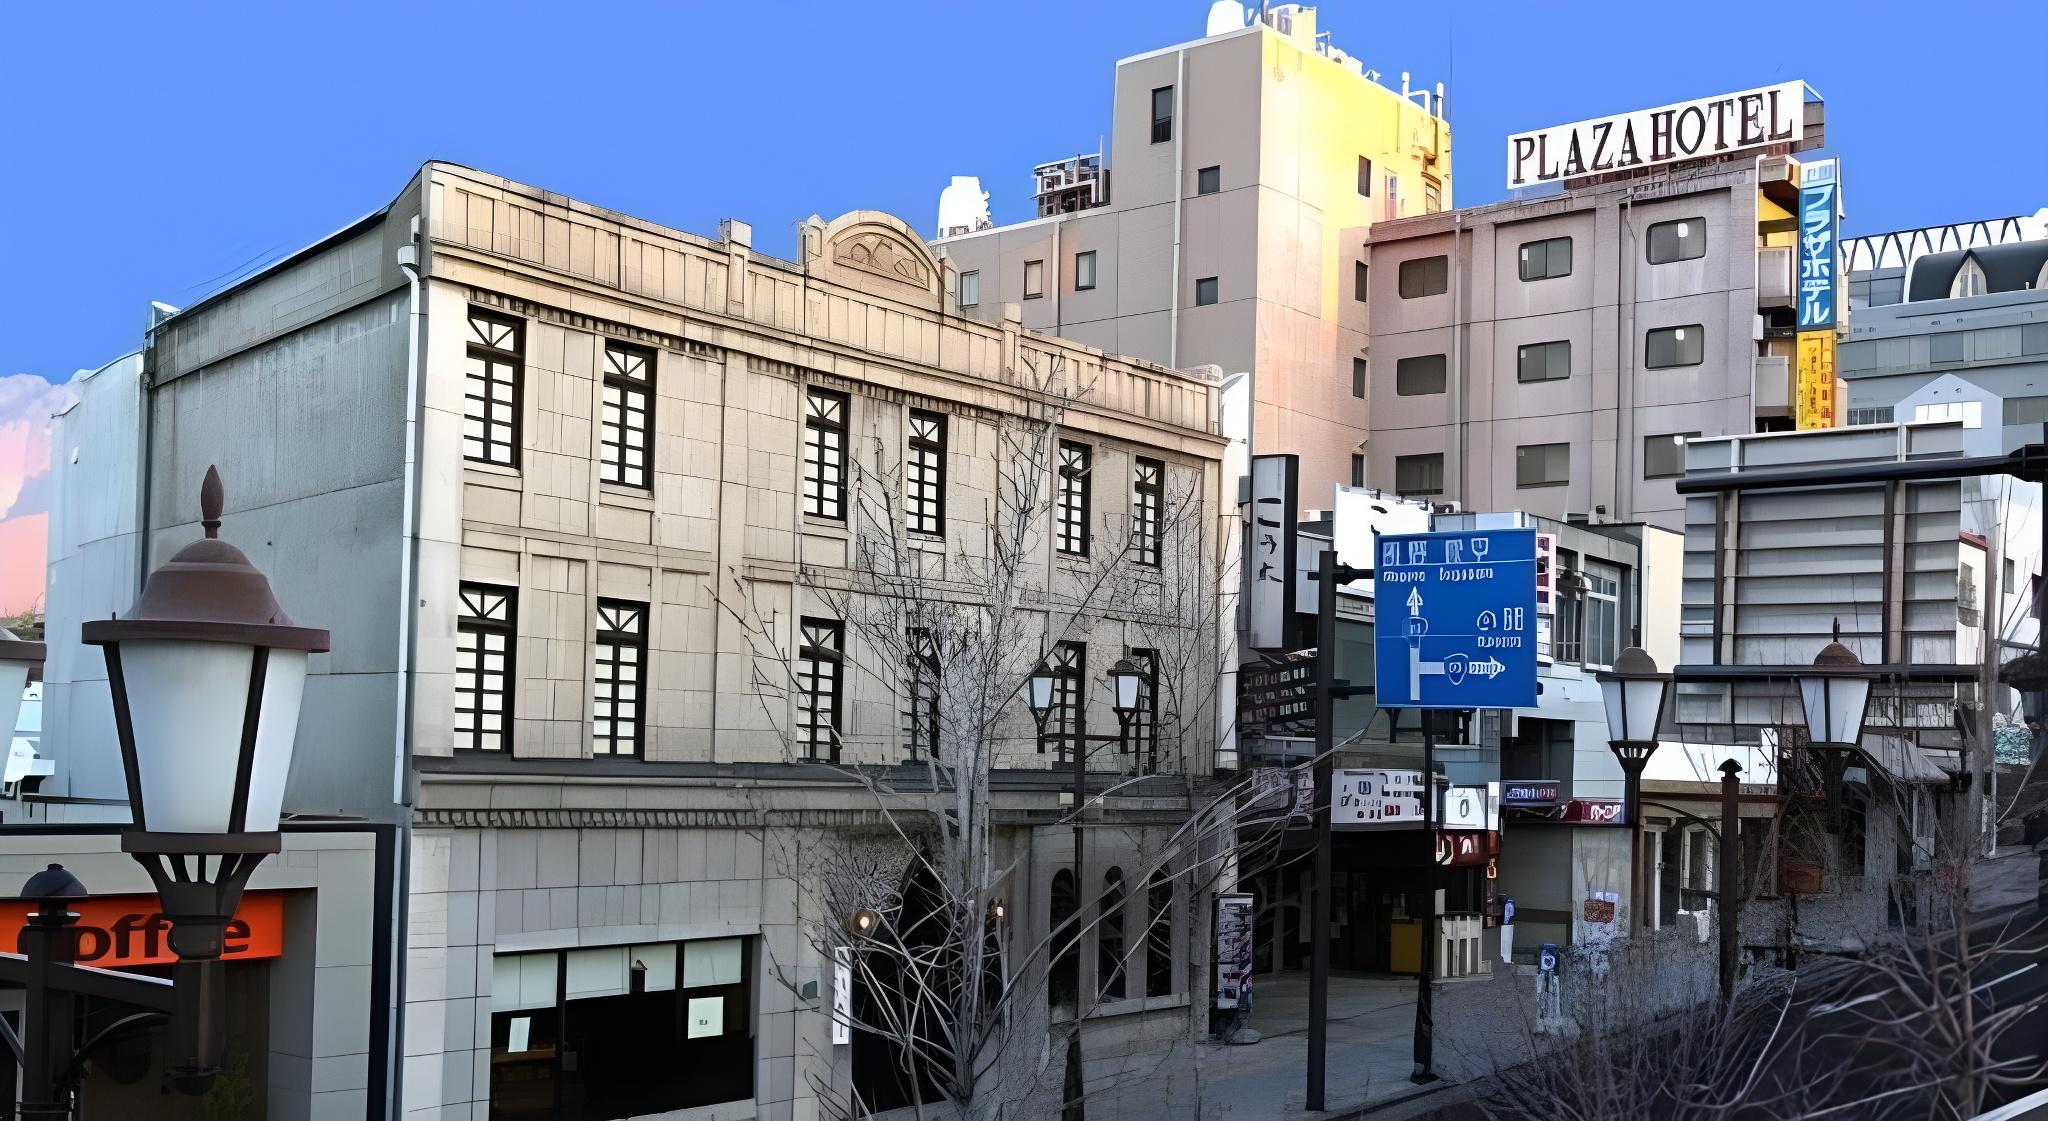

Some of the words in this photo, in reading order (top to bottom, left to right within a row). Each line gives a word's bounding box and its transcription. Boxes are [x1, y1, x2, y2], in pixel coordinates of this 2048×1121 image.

[1513, 118, 1643, 184] PLAZA
[1650, 89, 1793, 158] HOTEL
[17, 913, 251, 961] offe
